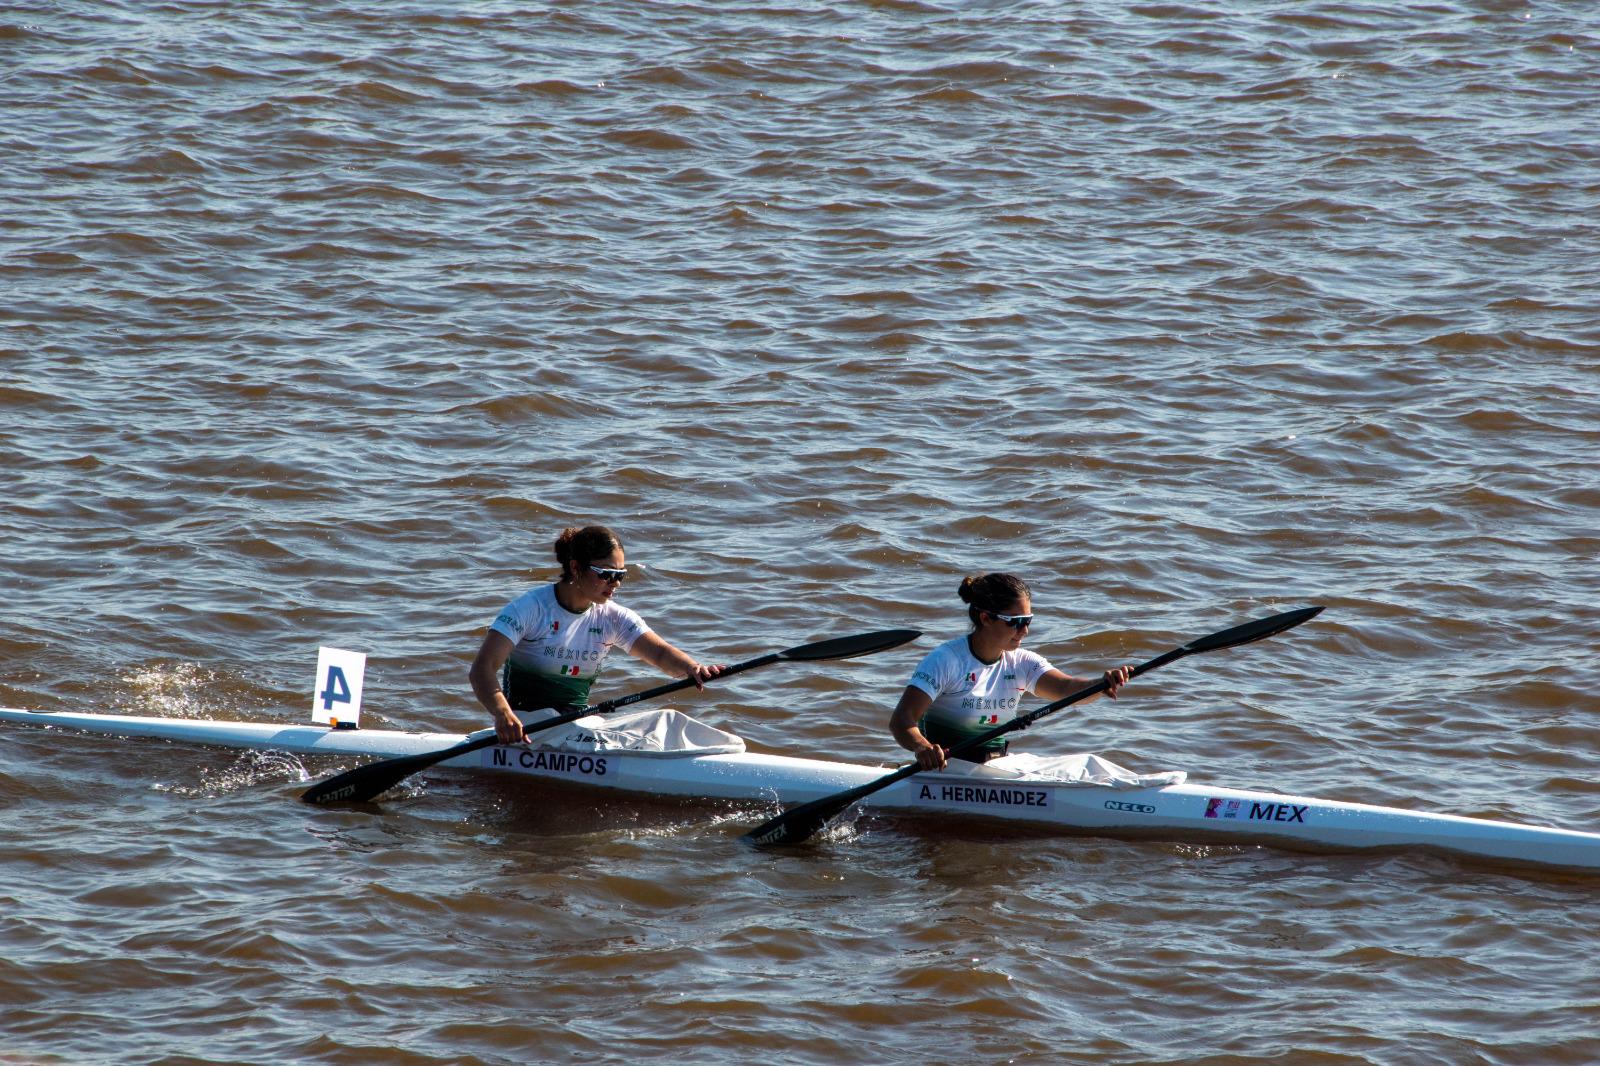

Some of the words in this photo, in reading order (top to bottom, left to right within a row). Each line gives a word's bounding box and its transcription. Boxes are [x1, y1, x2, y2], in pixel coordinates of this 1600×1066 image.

[493, 749, 513, 767] N.
[519, 750, 608, 776] CAMPOS
[920, 785, 937, 801] A.
[942, 786, 1048, 807] HERNANDEZ
[1106, 801, 1154, 813] NELO
[1250, 802, 1309, 823] MEX
